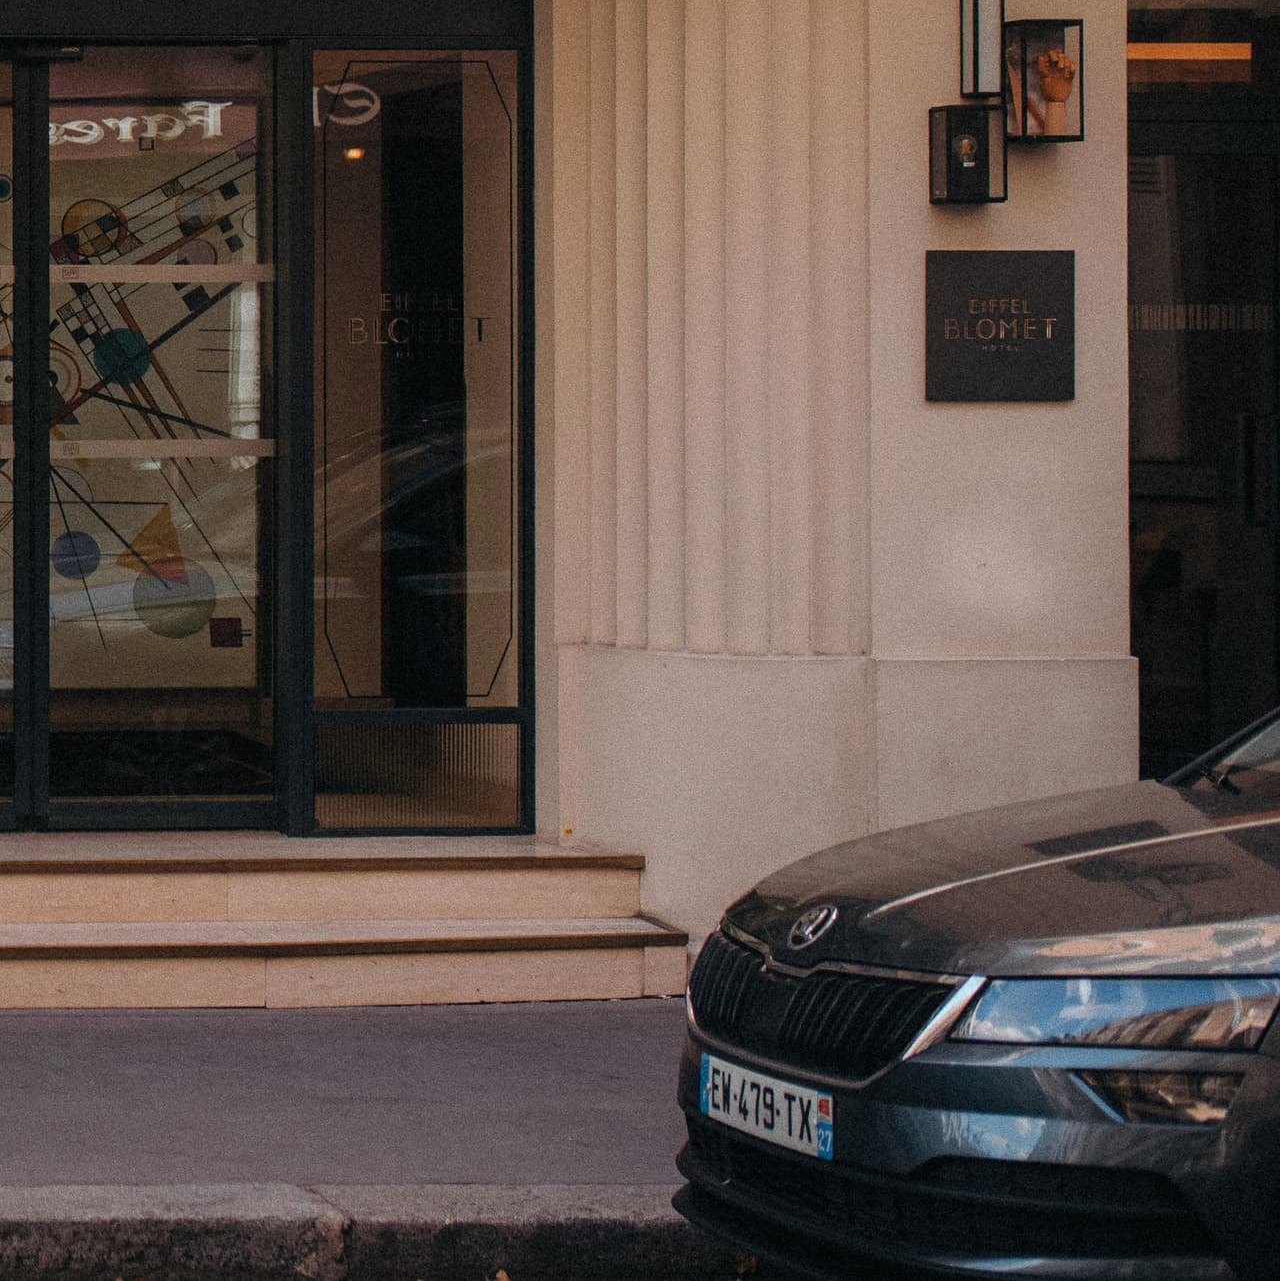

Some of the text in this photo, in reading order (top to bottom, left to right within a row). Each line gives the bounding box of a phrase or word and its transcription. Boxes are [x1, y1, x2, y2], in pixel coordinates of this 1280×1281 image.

[968, 298, 1032, 314] EIFFEL
[944, 317, 1057, 340] BLOMET
[818, 1129, 833, 1154] 27
